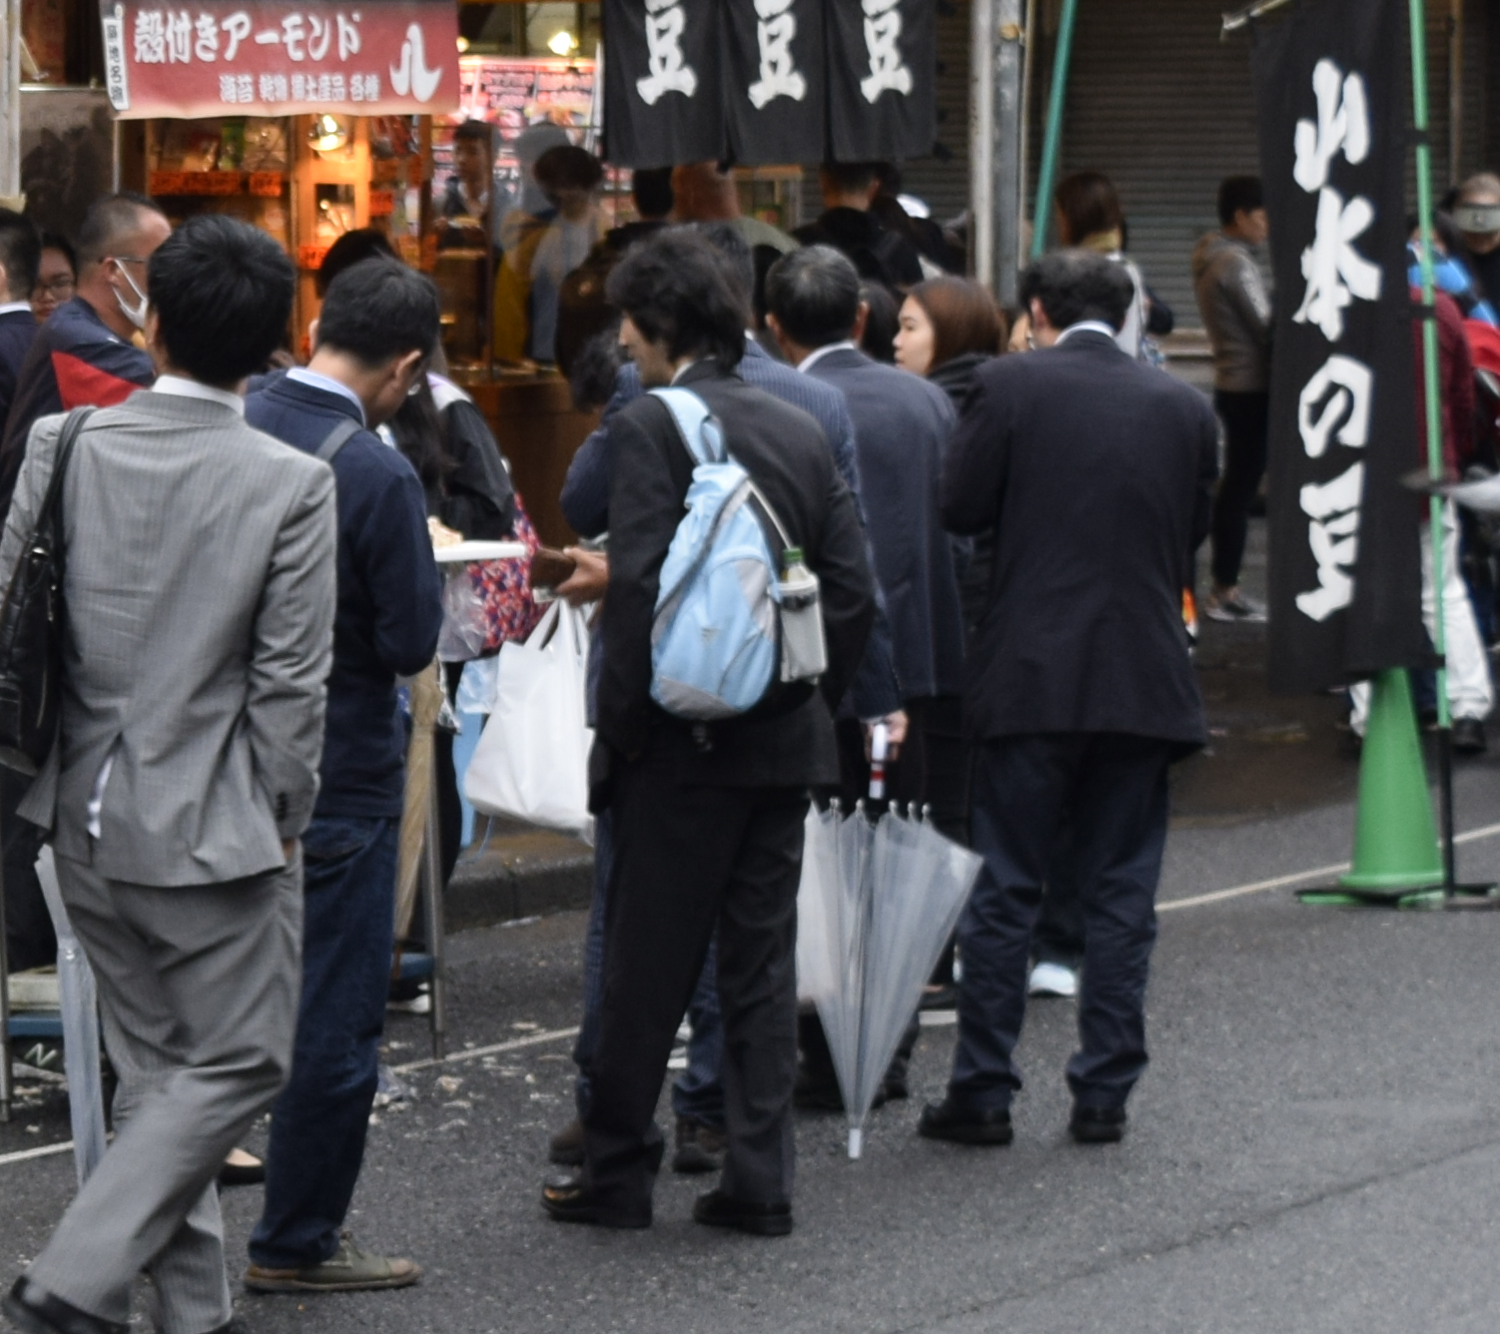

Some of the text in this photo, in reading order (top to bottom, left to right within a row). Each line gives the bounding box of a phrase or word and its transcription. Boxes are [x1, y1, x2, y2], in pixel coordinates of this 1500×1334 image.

[133, 9, 364, 65] 殻付きアーモンド
[349, 73, 381, 104] 各種
[1292, 56, 1384, 623] 山本の豆
